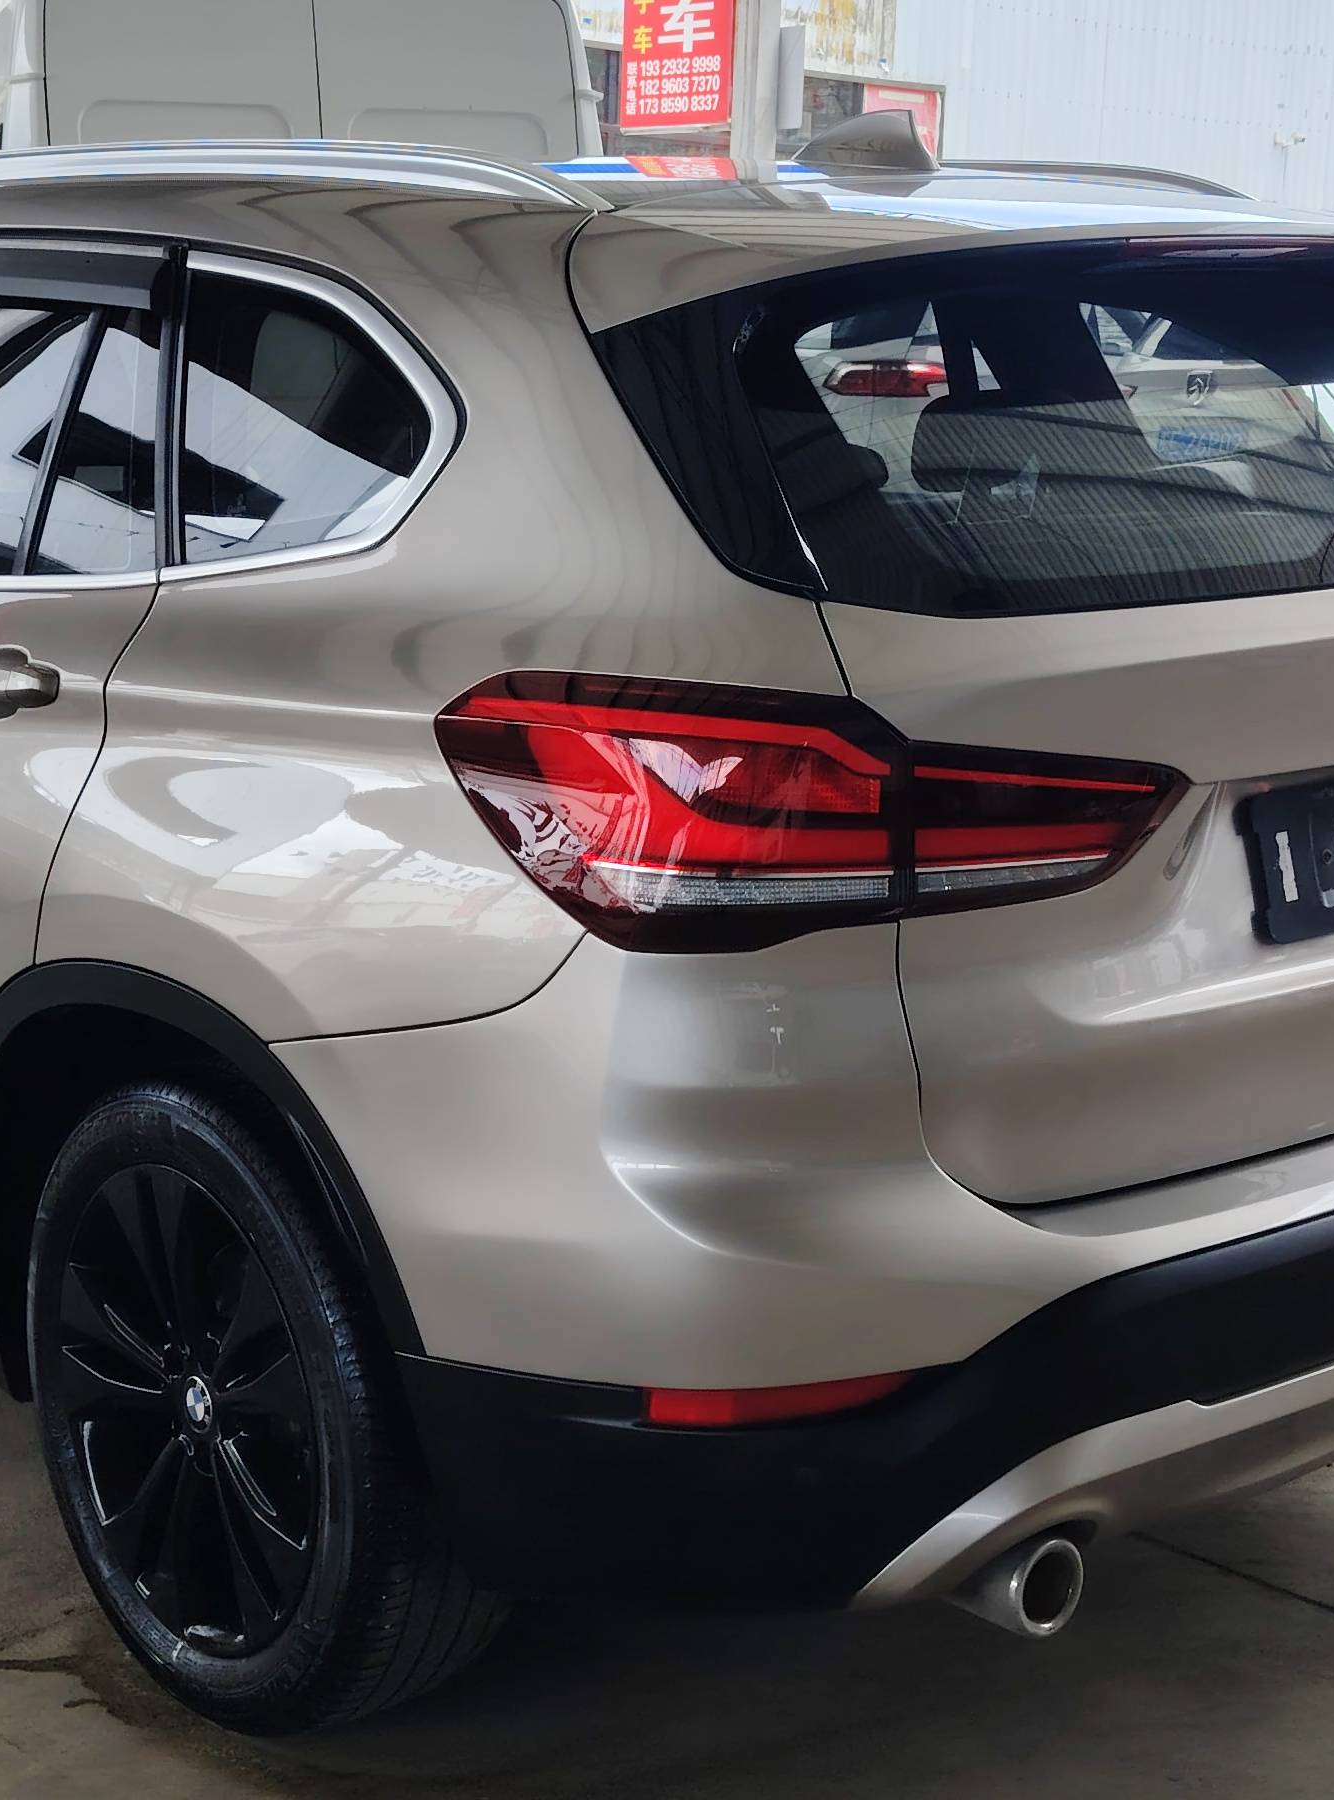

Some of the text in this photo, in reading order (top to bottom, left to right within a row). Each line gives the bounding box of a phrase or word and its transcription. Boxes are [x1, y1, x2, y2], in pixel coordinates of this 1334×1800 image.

[640, 55, 721, 77] 193 2932 9998
[639, 75, 720, 96] 182 9603 7370
[639, 94, 719, 115] 173 8590 8337
